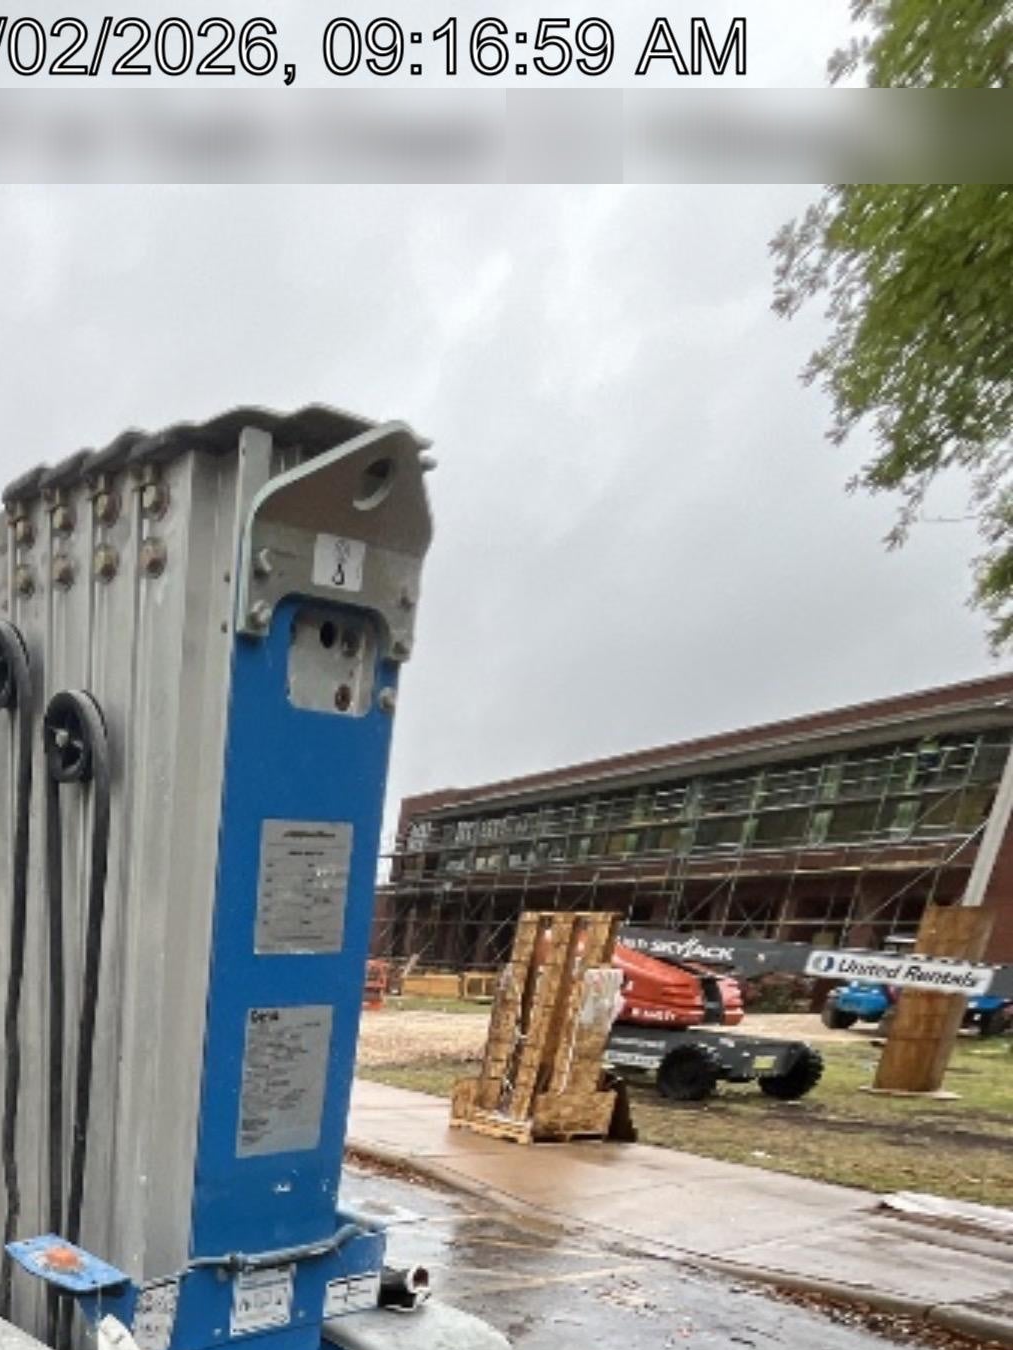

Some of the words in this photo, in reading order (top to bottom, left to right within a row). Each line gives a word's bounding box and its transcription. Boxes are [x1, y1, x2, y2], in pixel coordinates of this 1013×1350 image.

[649, 937, 735, 961] SKYJACK
[839, 958, 899, 979] United
[903, 964, 978, 988] Rentals
